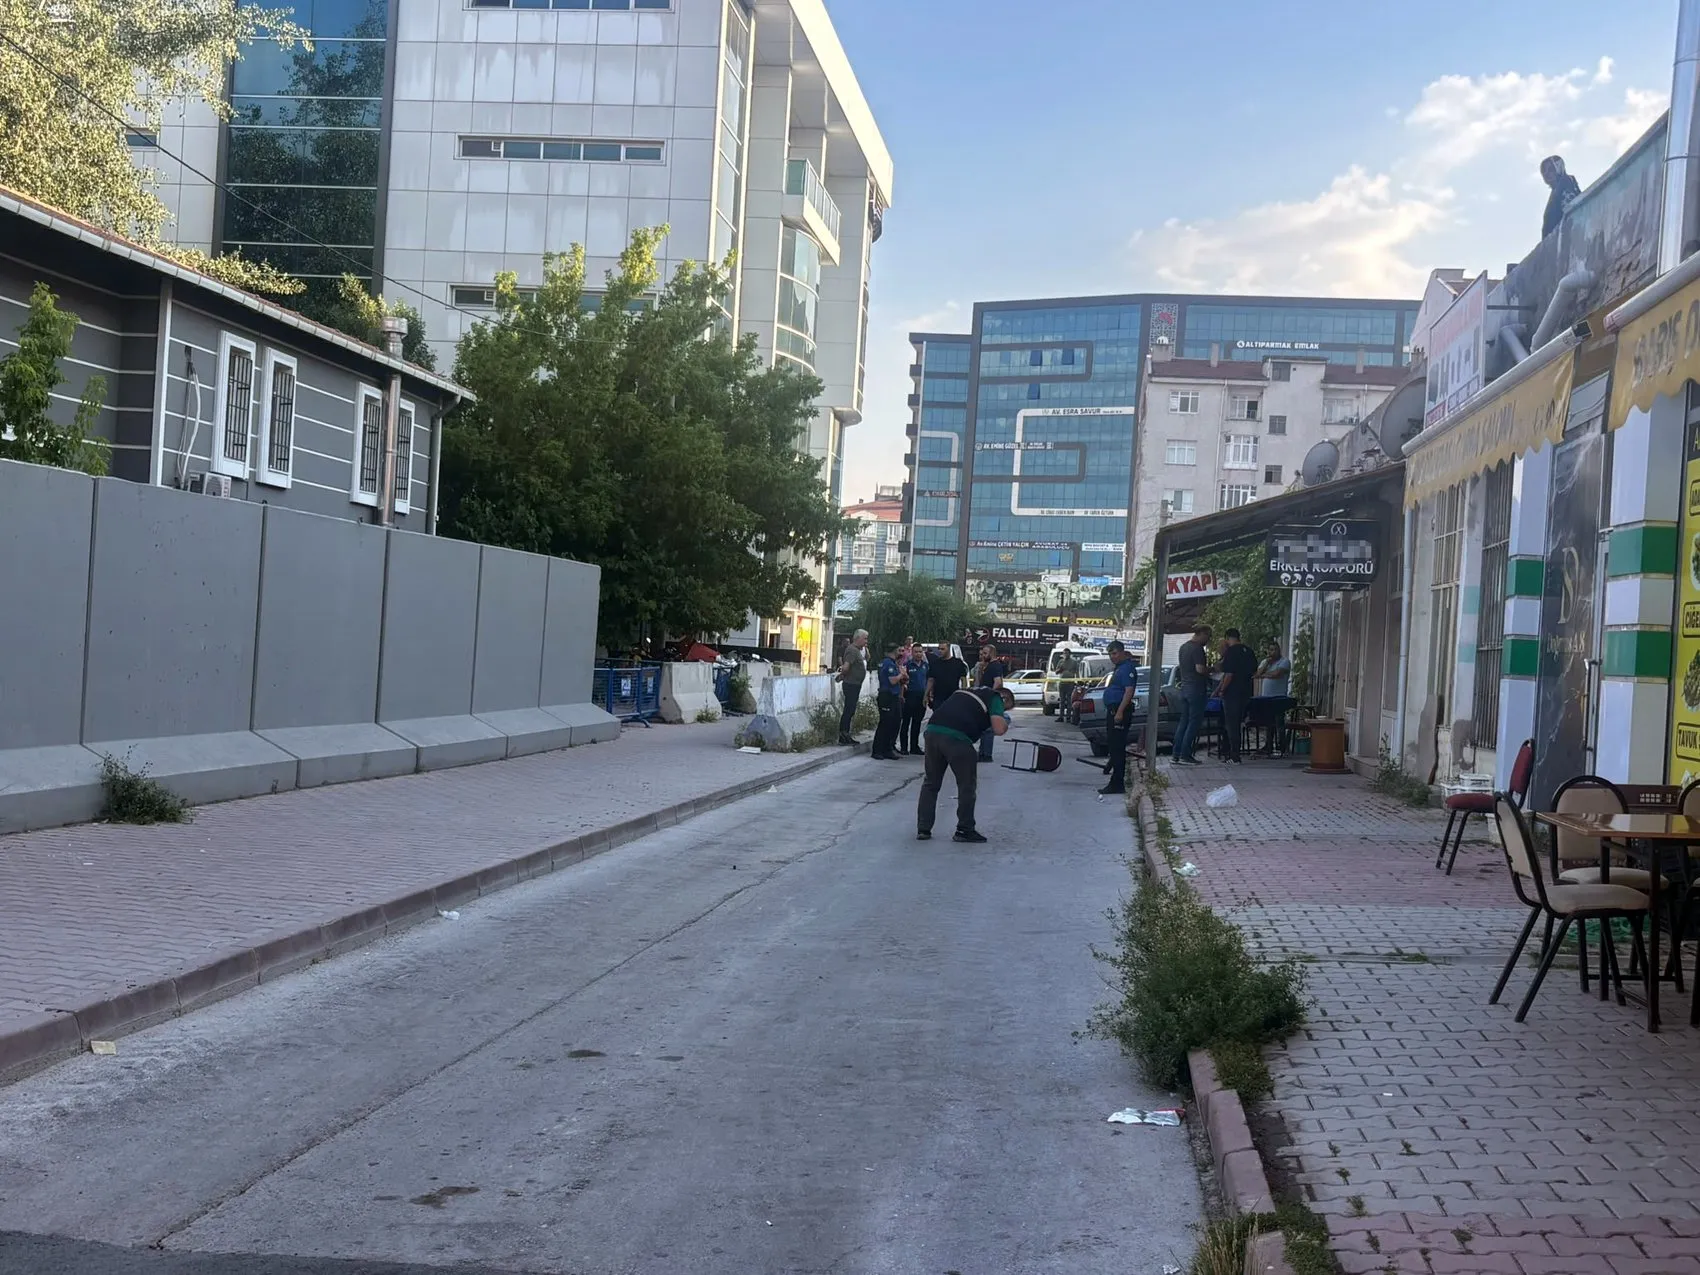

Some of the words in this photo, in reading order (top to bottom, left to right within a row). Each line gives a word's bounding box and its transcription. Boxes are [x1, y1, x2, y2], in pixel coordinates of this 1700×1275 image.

[1245, 341, 1291, 349] ALTIPARMAK
[1294, 342, 1319, 350] EMLAK
[1166, 571, 1218, 594] KYAPI
[992, 627, 1039, 639] FALCON
